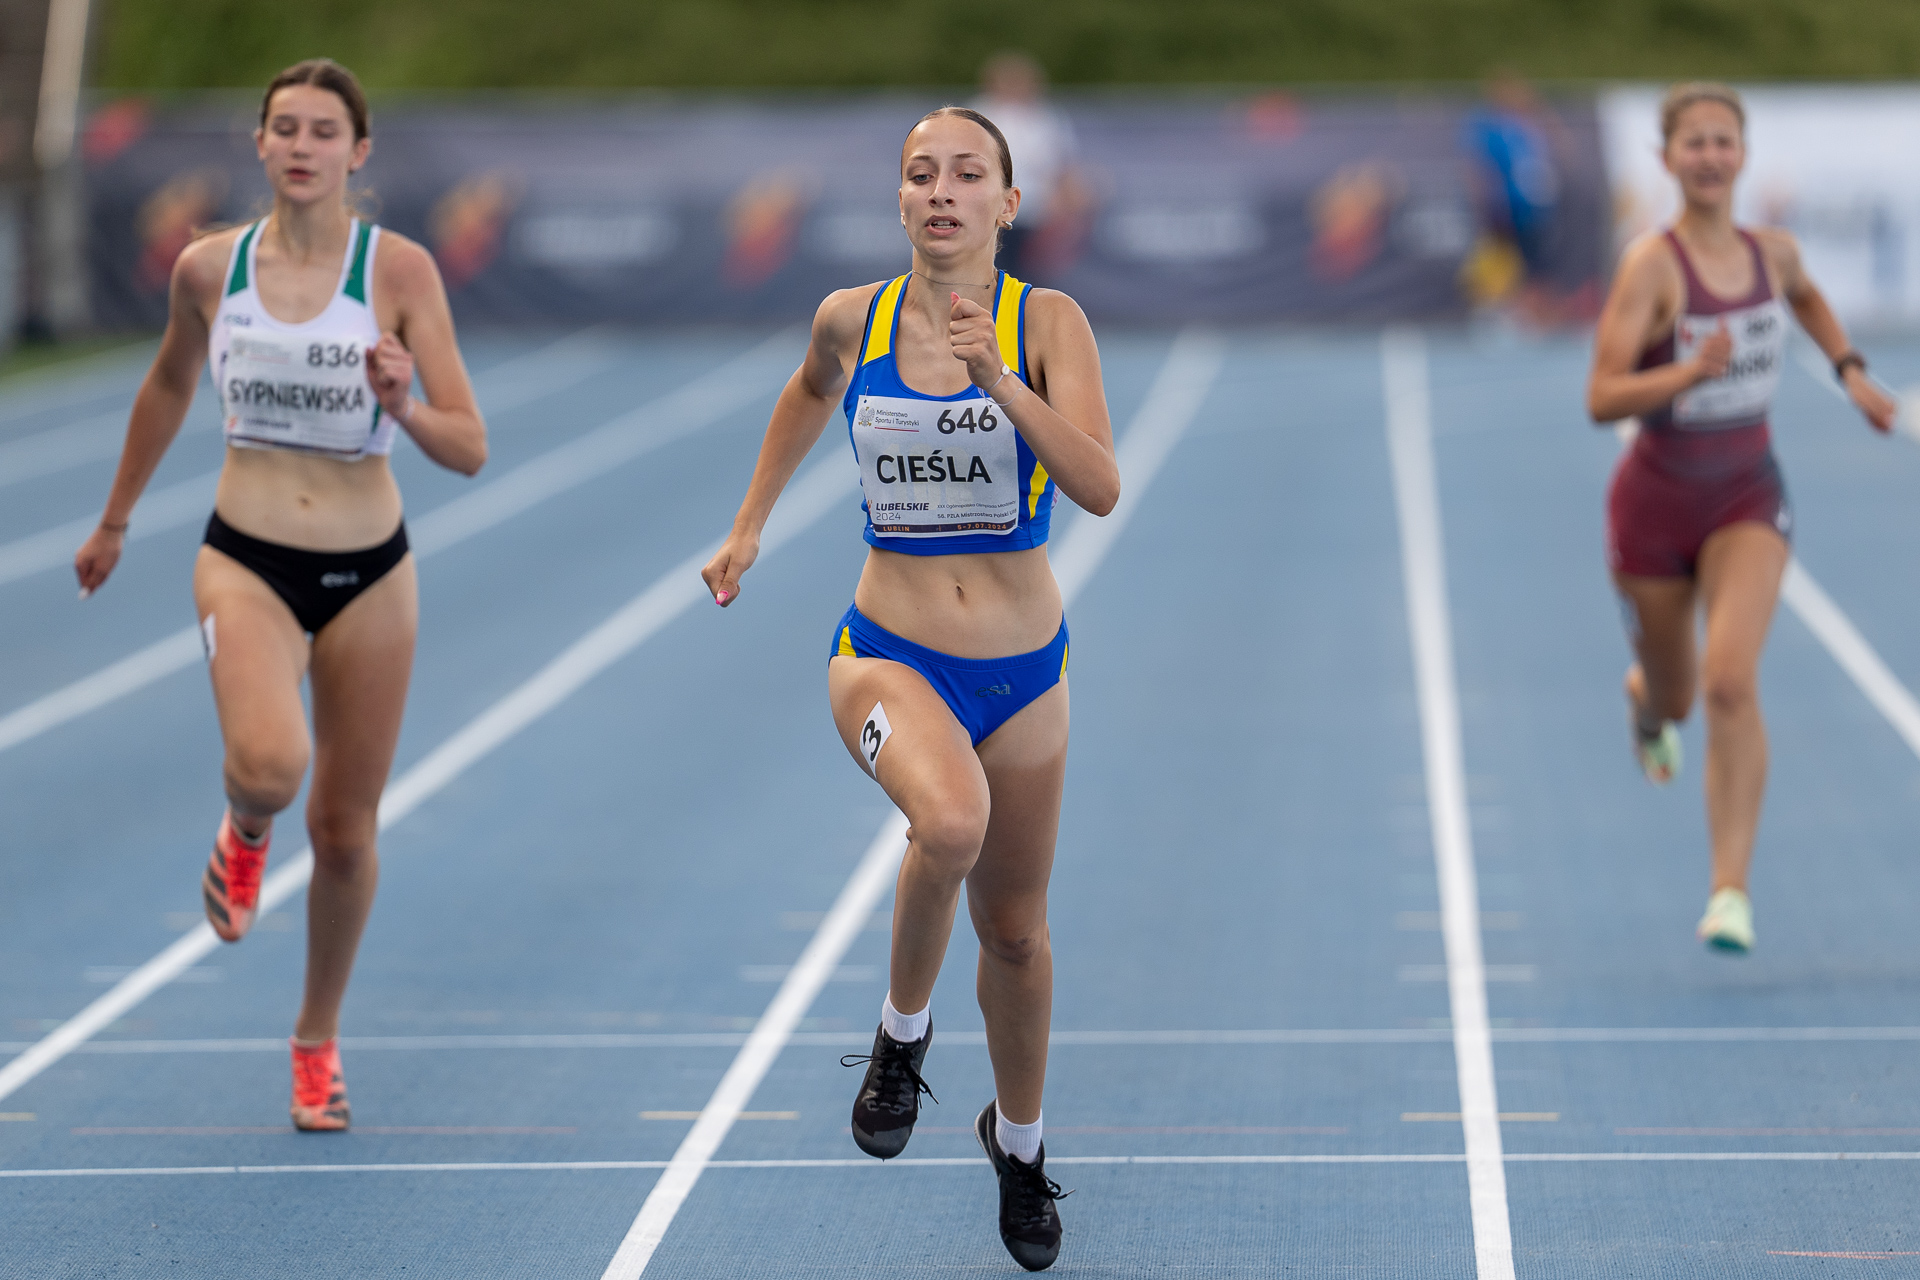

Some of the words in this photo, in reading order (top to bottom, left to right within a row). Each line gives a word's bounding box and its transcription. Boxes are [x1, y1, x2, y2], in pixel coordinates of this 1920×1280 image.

[307, 343, 360, 368] 836
[228, 378, 365, 413] SYPNIEWSKA
[875, 416, 892, 424] Sportu
[895, 418, 920, 427] Turystyki
[876, 409, 909, 418] Ministerstwo
[937, 404, 998, 435] 646
[876, 450, 993, 485] CIEŚLA
[876, 502, 930, 511] LUBELSKIE
[876, 512, 902, 520] 2024
[863, 720, 882, 762] 3
